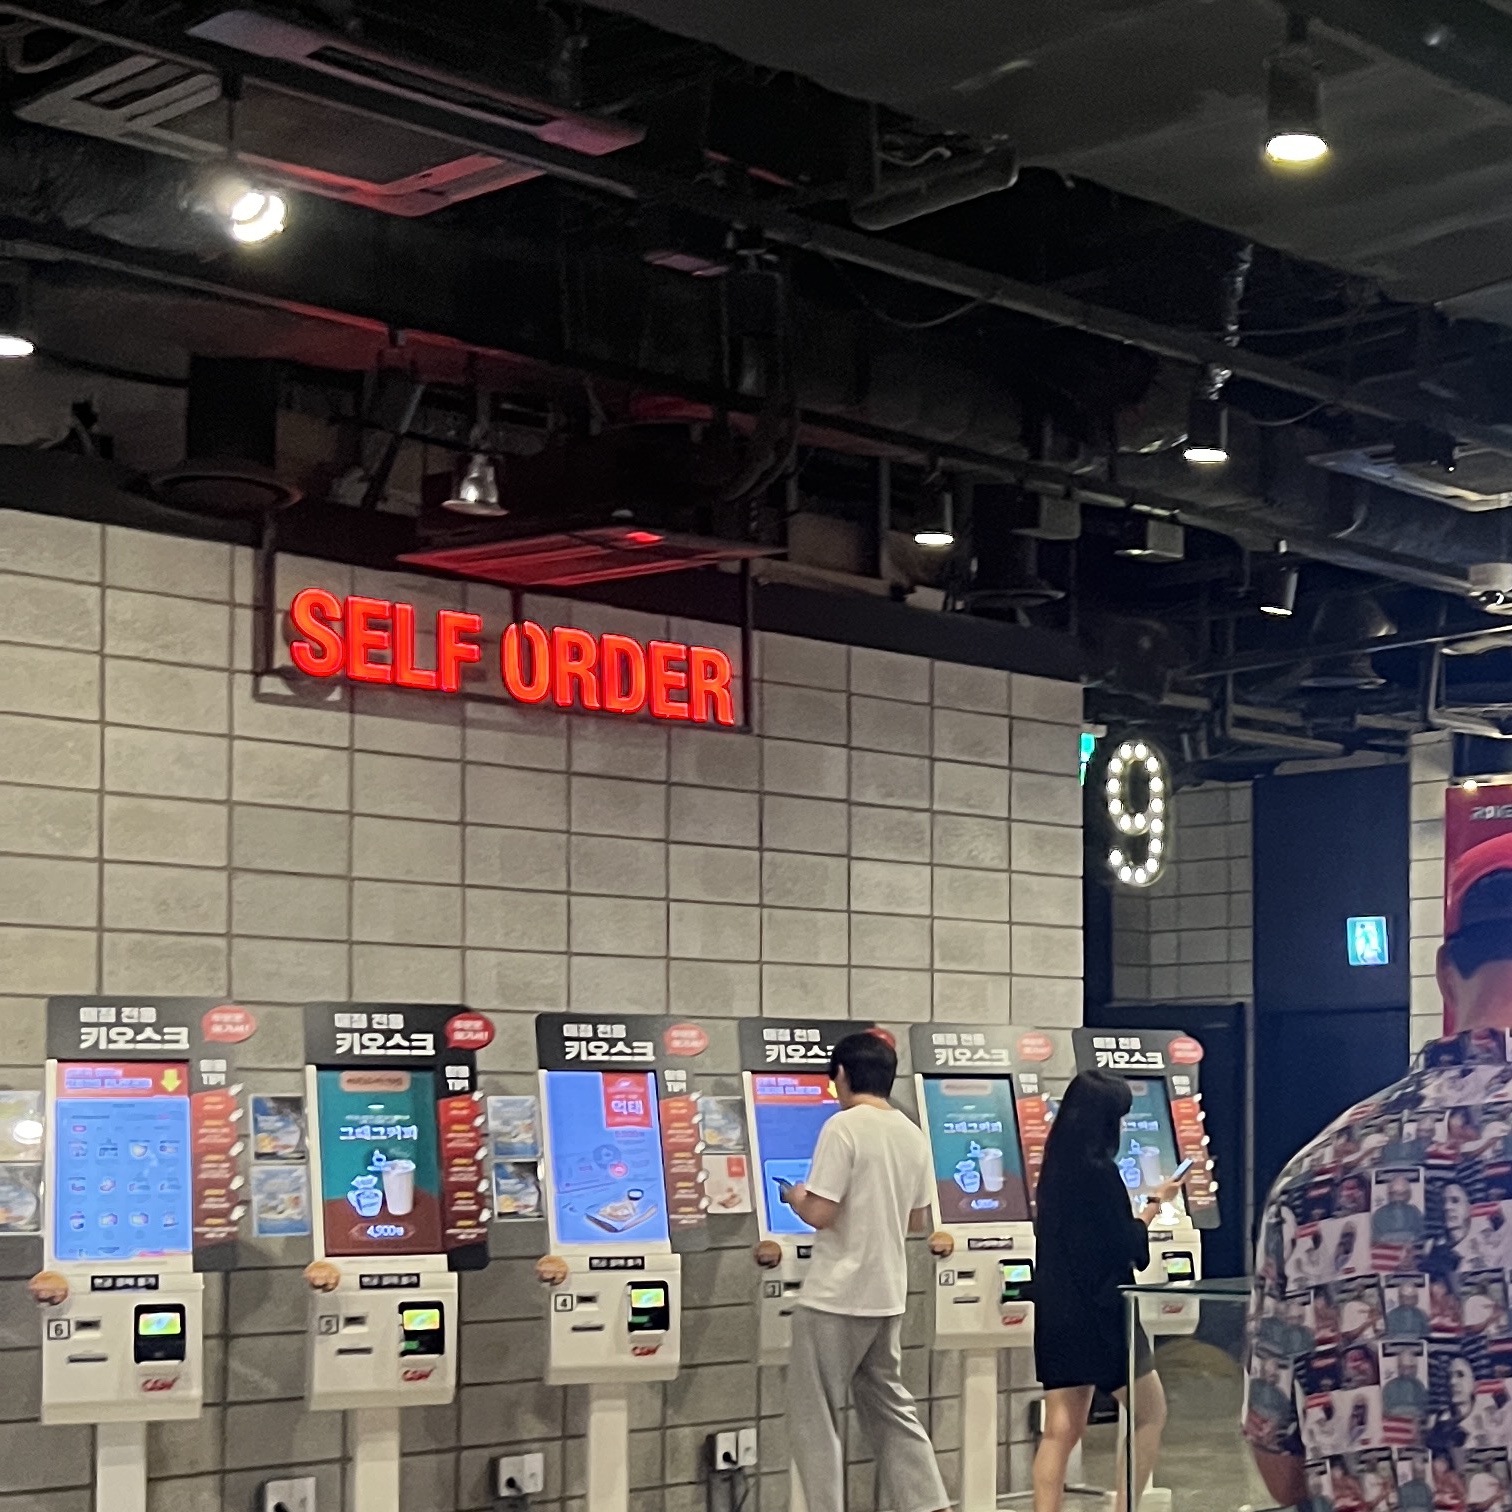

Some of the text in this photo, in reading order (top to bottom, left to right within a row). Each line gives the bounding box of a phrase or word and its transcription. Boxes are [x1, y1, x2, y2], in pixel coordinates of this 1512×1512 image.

[289, 587, 735, 727] SELF ORDER
[1105, 738, 1170, 888] 9
[79, 1027, 190, 1050] 키오스크
[335, 1032, 436, 1056] 키오스크
[564, 1041, 656, 1062] 키오스크
[934, 1048, 1012, 1067] 키오스크
[1095, 1051, 1165, 1069] 키오스크
